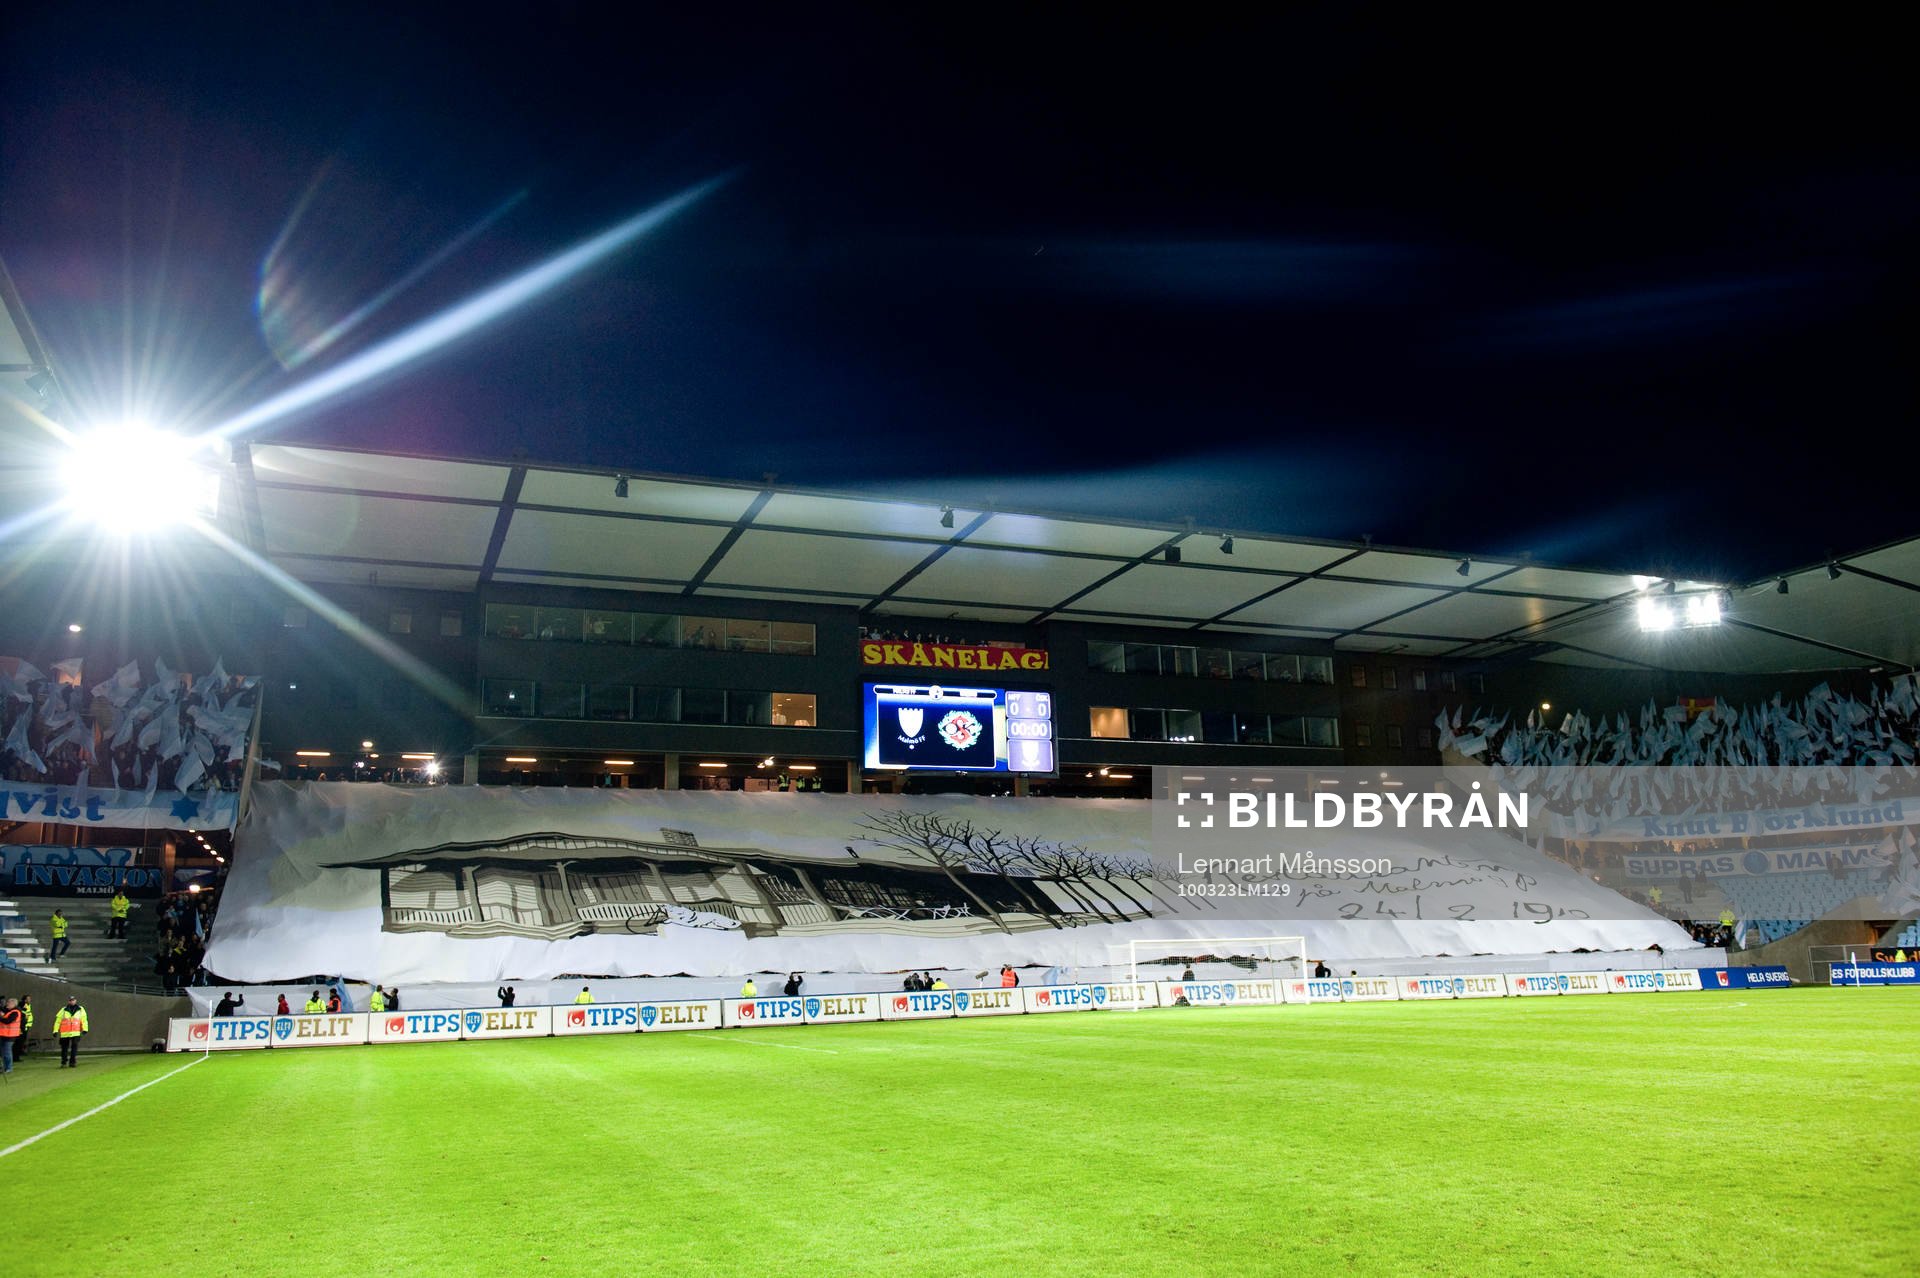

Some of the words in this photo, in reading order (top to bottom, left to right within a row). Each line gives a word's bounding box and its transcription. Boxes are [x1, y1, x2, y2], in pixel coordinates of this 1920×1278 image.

[1010, 702, 1019, 715] 0
[1038, 703, 1047, 716] 0
[1010, 722, 1048, 736] 00:00
[1642, 816, 1721, 838] Knut
[1629, 855, 1735, 876] SUPRAS
[76, 885, 114, 894] MALMÖ
[1625, 974, 1655, 988] TIPS
[1665, 972, 1693, 986] ELIT
[1747, 972, 1766, 983] HELA
[1832, 968, 1844, 979] ES
[1844, 967, 1916, 979] FOTBOLLSKLUBB
[1308, 982, 1341, 997] TIPS
[1355, 980, 1389, 996] ELIT
[1419, 979, 1453, 994] TIPS
[1466, 977, 1497, 992] ELIT
[1527, 976, 1558, 991] TIPS
[1568, 975, 1598, 989] ELIT
[1051, 988, 1091, 1005] TIPS
[1184, 985, 1222, 1001] TIPS
[1236, 983, 1273, 999] ELIT
[757, 1000, 802, 1018] TIPS
[823, 997, 867, 1016] ELIT
[909, 993, 952, 1011] TIPS
[972, 991, 1012, 1009] ELIT
[408, 1014, 460, 1034] TIPS
[485, 1011, 537, 1031] ELIT
[588, 1007, 637, 1027] TIPS
[660, 1005, 708, 1024] ELIT
[213, 1020, 269, 1041] TIPS
[296, 1017, 353, 1038] ELIT
